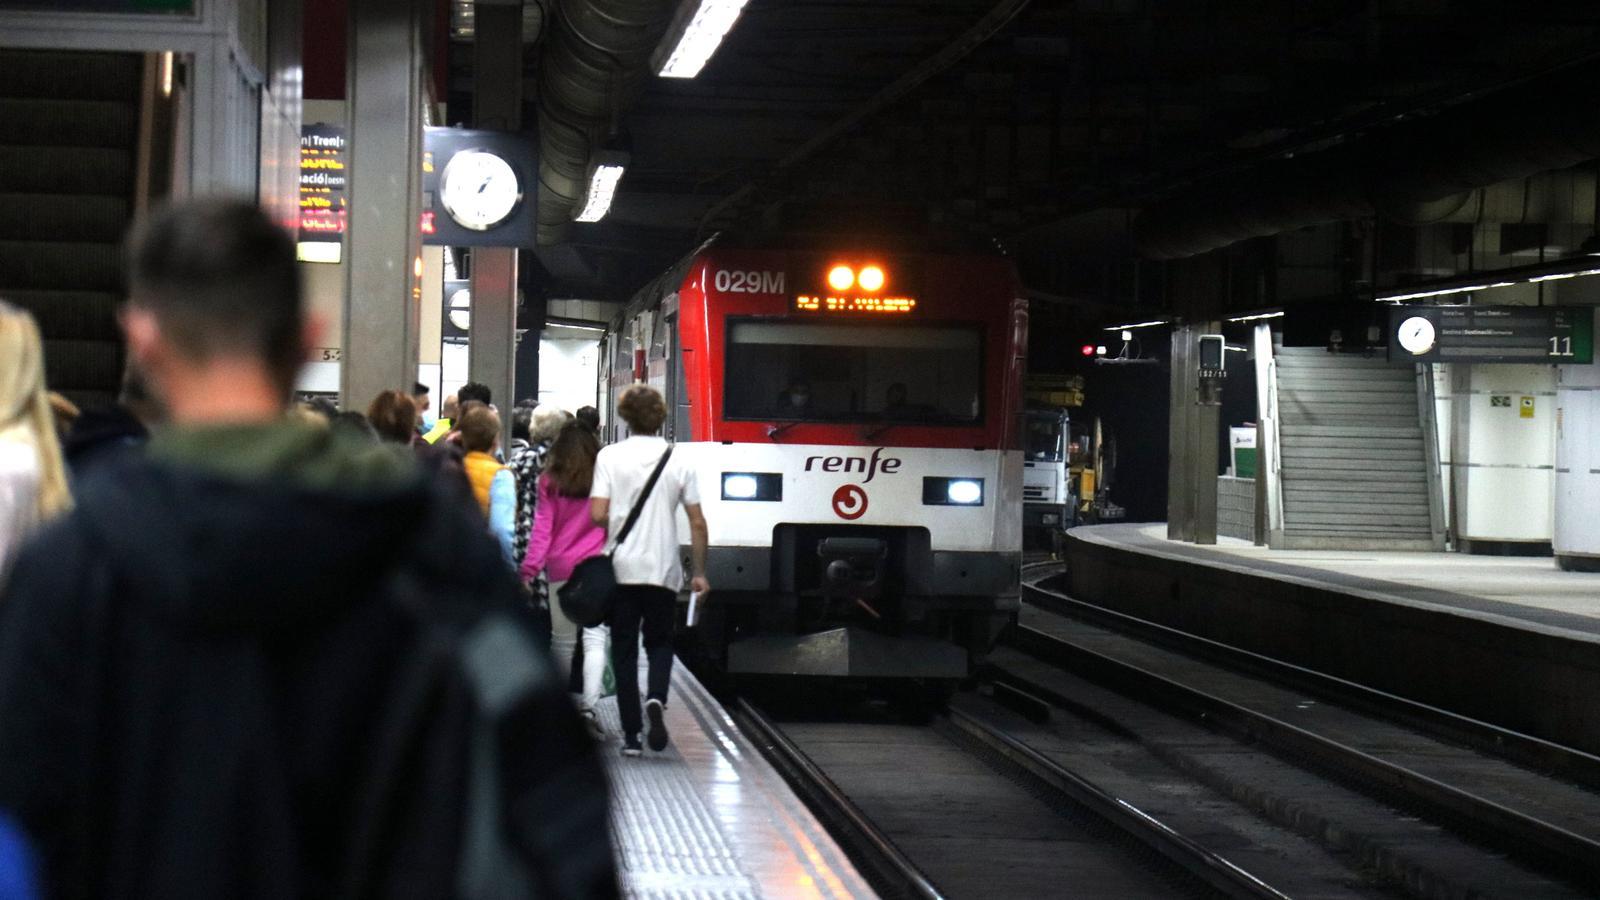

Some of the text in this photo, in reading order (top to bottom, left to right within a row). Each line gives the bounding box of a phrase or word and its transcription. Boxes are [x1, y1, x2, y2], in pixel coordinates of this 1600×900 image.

[715, 270, 785, 294] 029M
[1549, 336, 1574, 356] 11
[804, 447, 902, 484] renfe
